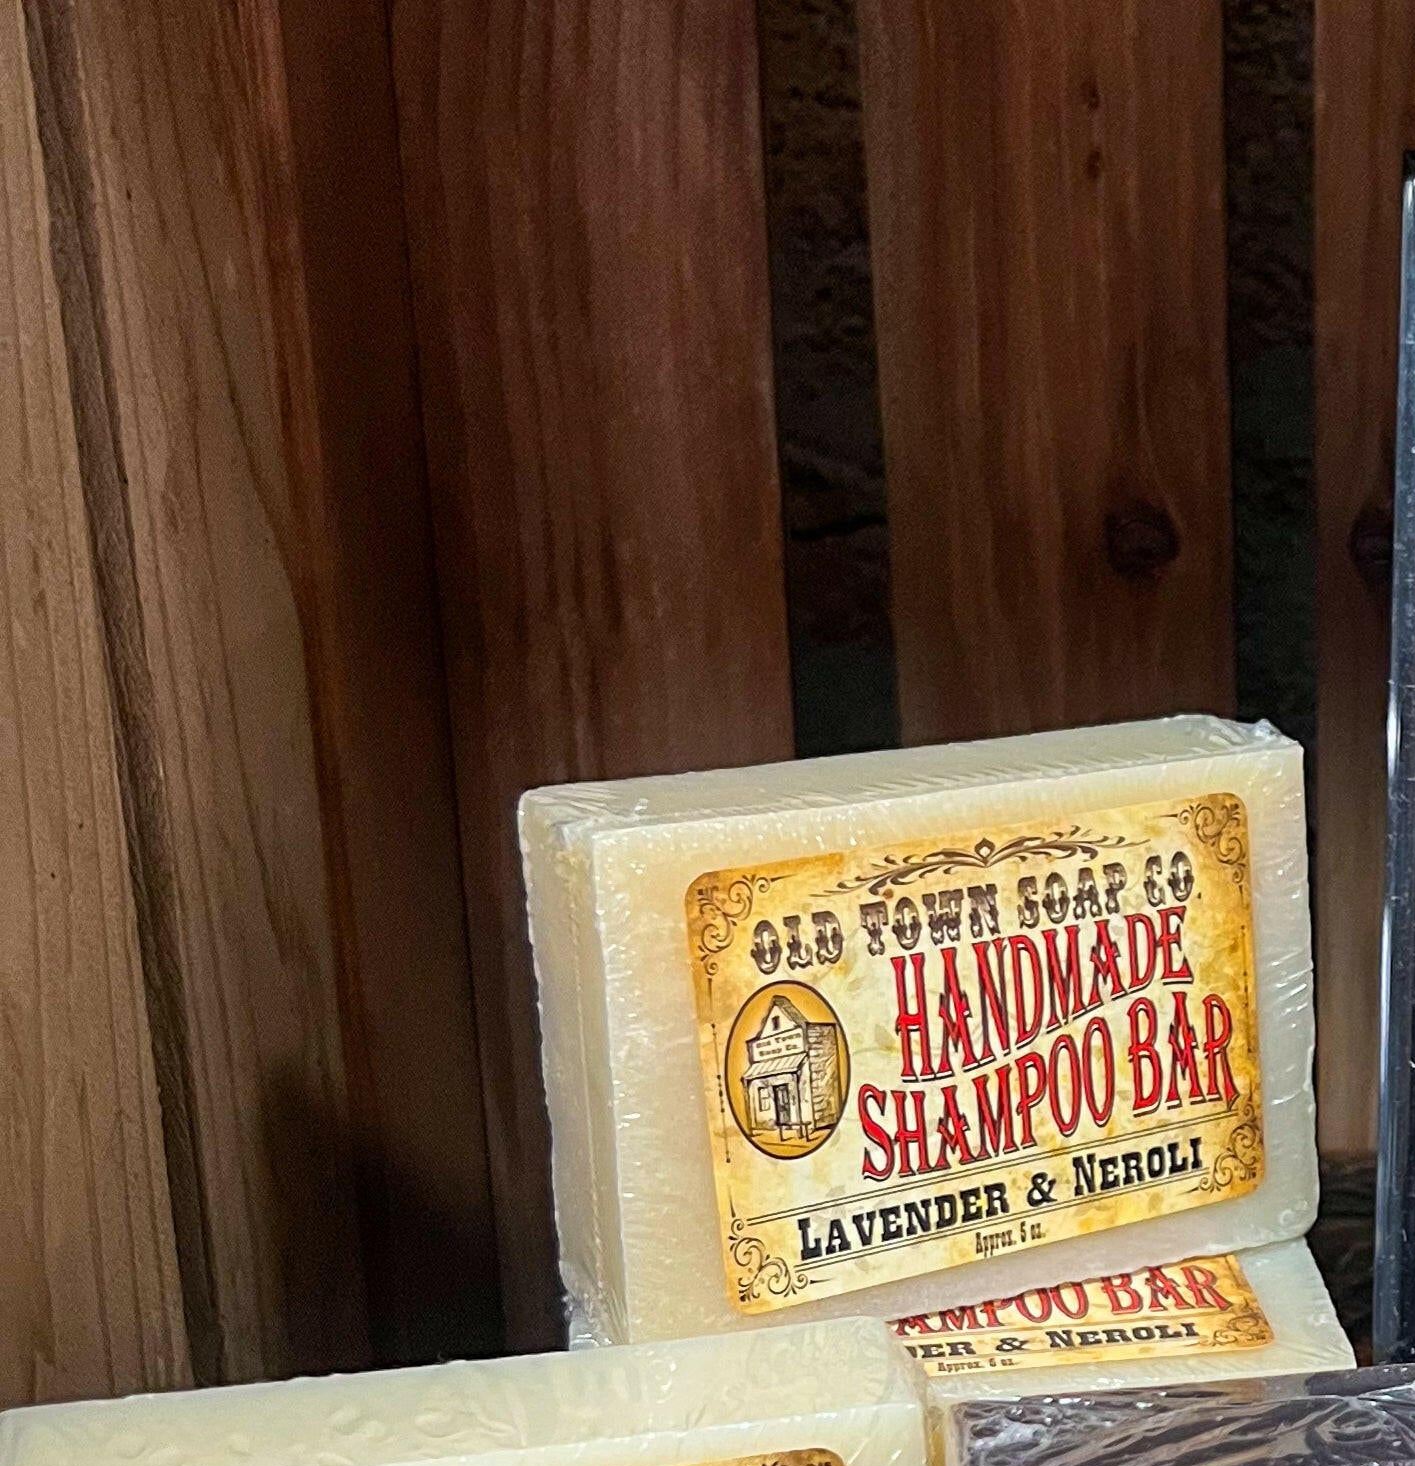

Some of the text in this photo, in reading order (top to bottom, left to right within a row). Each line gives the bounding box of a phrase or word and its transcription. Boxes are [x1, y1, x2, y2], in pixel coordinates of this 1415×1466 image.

[750, 850, 1202, 976] OLD TOWN SOAP CO.
[890, 905, 1195, 1084] HANDMADE
[857, 992, 1240, 1181] SHAMPOO BAR
[797, 1137, 1204, 1262] LAVENDER & NEROLI
[995, 1337, 1029, 1353] &
[1045, 1322, 1200, 1349] NEROLI
[1102, 1265, 1233, 1316] BAR
